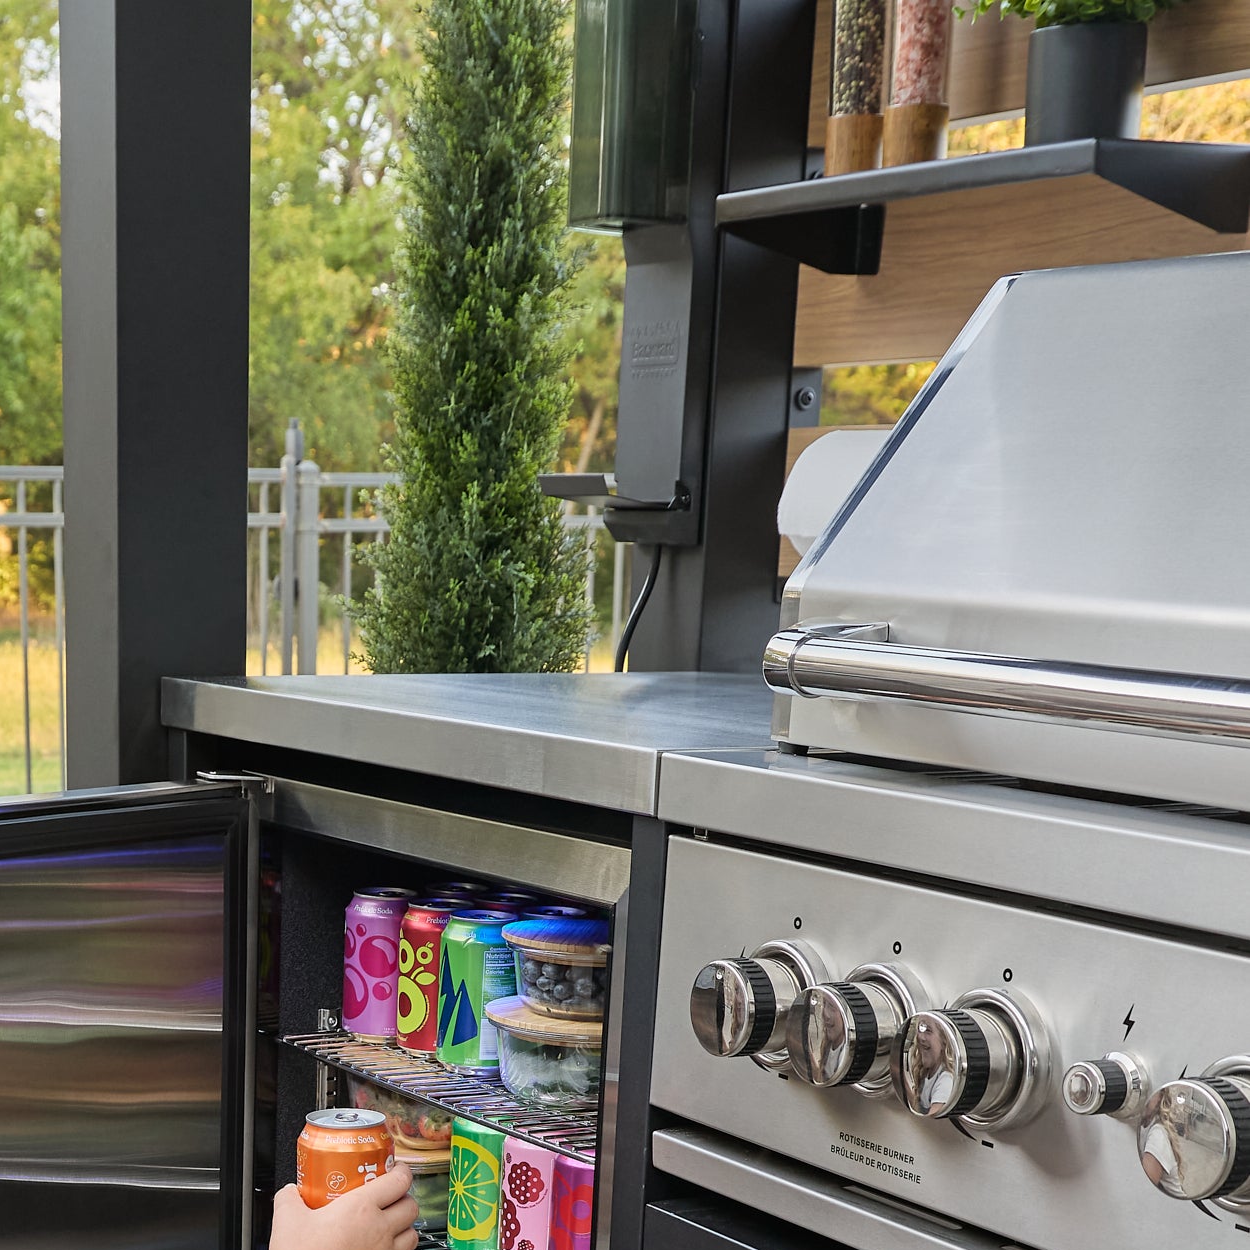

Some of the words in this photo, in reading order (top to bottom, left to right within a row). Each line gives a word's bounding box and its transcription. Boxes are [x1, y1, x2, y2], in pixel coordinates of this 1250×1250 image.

[377, 907, 393, 915] Soda
[325, 1135, 356, 1144] Prebiotic
[357, 1135, 375, 1144] Soda
[839, 1131, 883, 1154] ROTISSERIE
[883, 1147, 915, 1165] BURNER
[830, 1144, 864, 1164] BRÛLEUR
[865, 1157, 876, 1168] DE
[876, 1161, 921, 1184] ROTISSERIE
